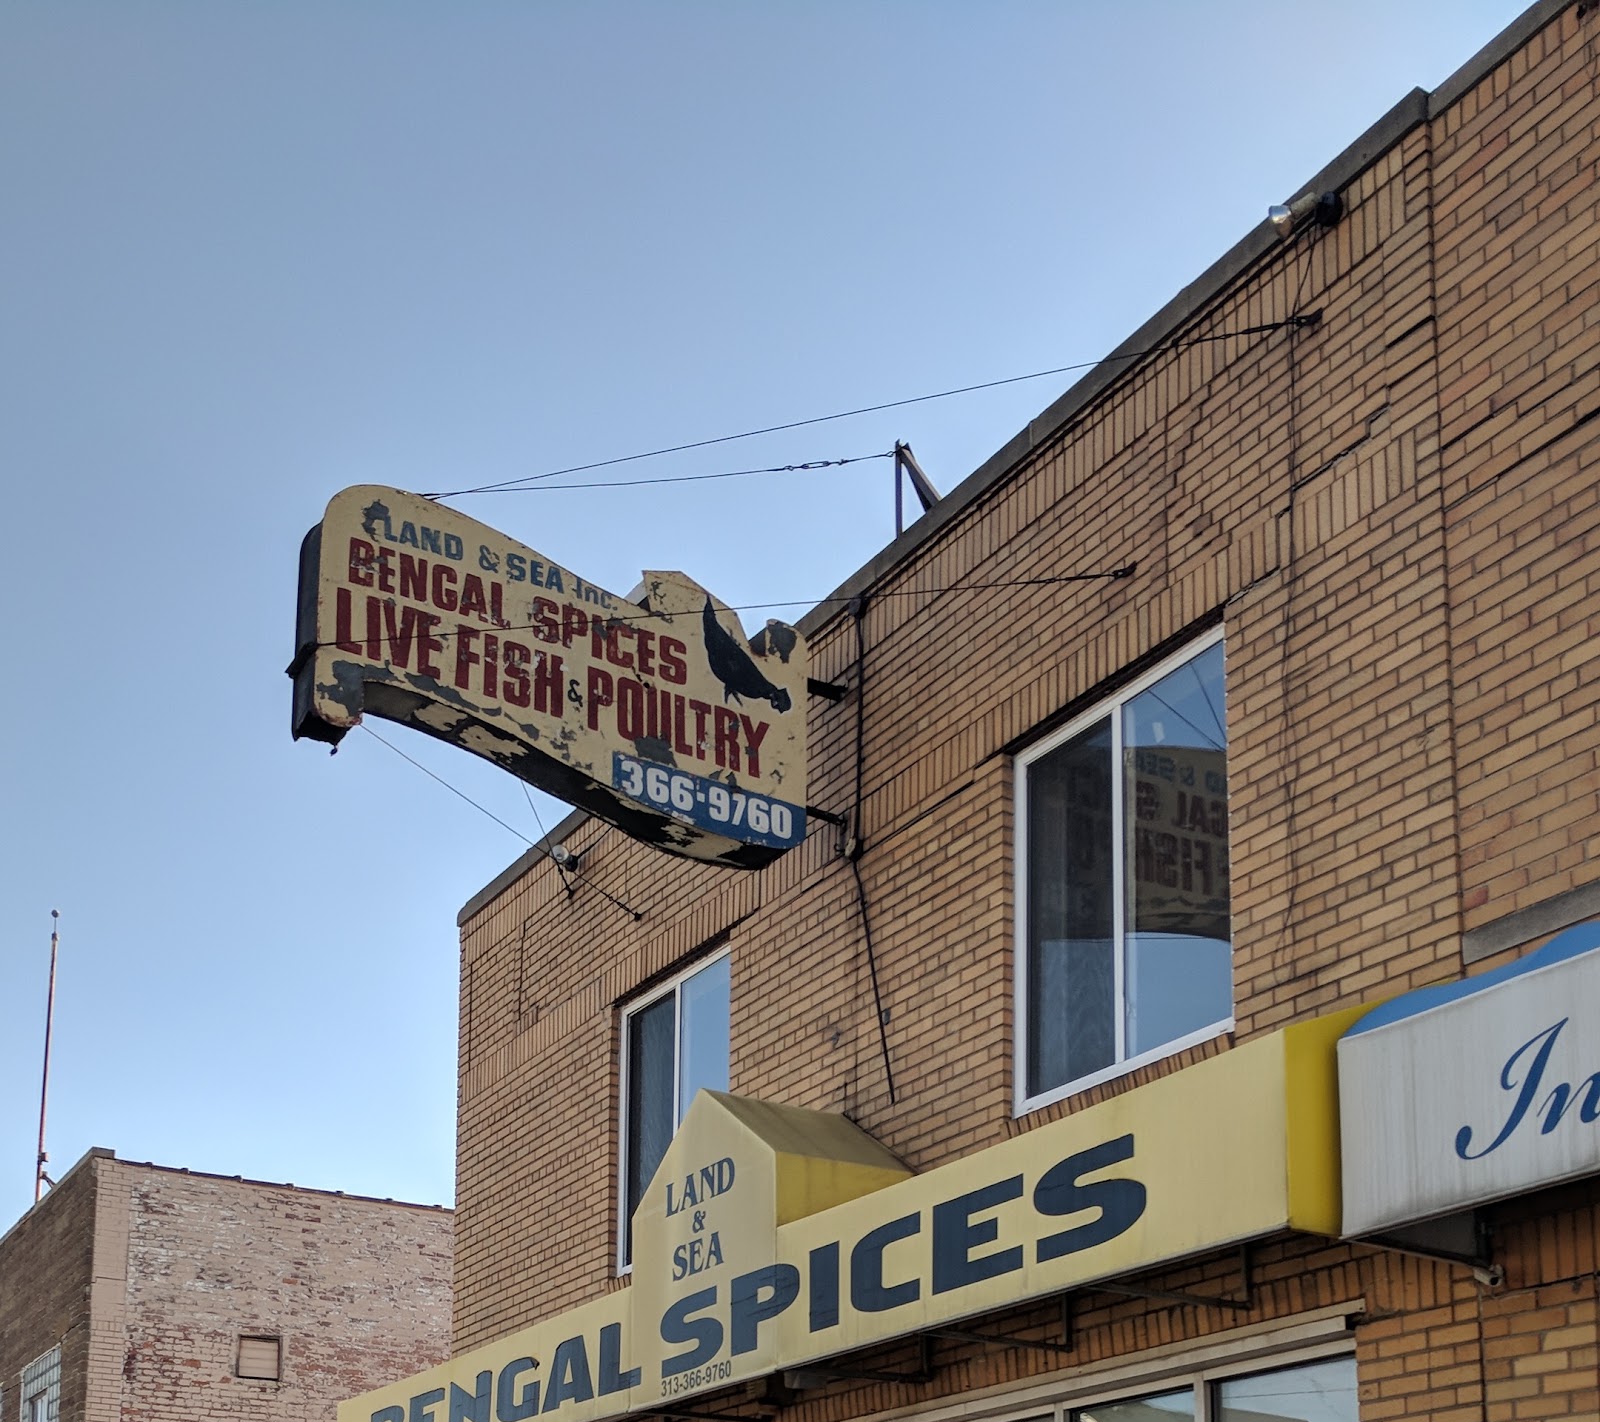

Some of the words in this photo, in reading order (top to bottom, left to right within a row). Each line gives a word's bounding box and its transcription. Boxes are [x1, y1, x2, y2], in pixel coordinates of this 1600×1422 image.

[384, 515, 463, 560] LAND
[479, 545, 500, 573] &
[506, 552, 564, 594] SEA
[348, 536, 510, 630] BENGAL
[533, 595, 687, 685] SPICES
[336, 587, 441, 680] LIVE
[455, 624, 564, 718] FISH
[567, 679, 583, 707] &
[587, 665, 770, 779] POULTRY
[620, 760, 793, 840] 366-9760
[665, 1157, 735, 1218] LAND
[691, 1210, 706, 1234] &
[660, 1133, 1147, 1379] SPICES
[672, 1231, 724, 1282] SEA
[661, 1360, 731, 1398] 313-366-9760
